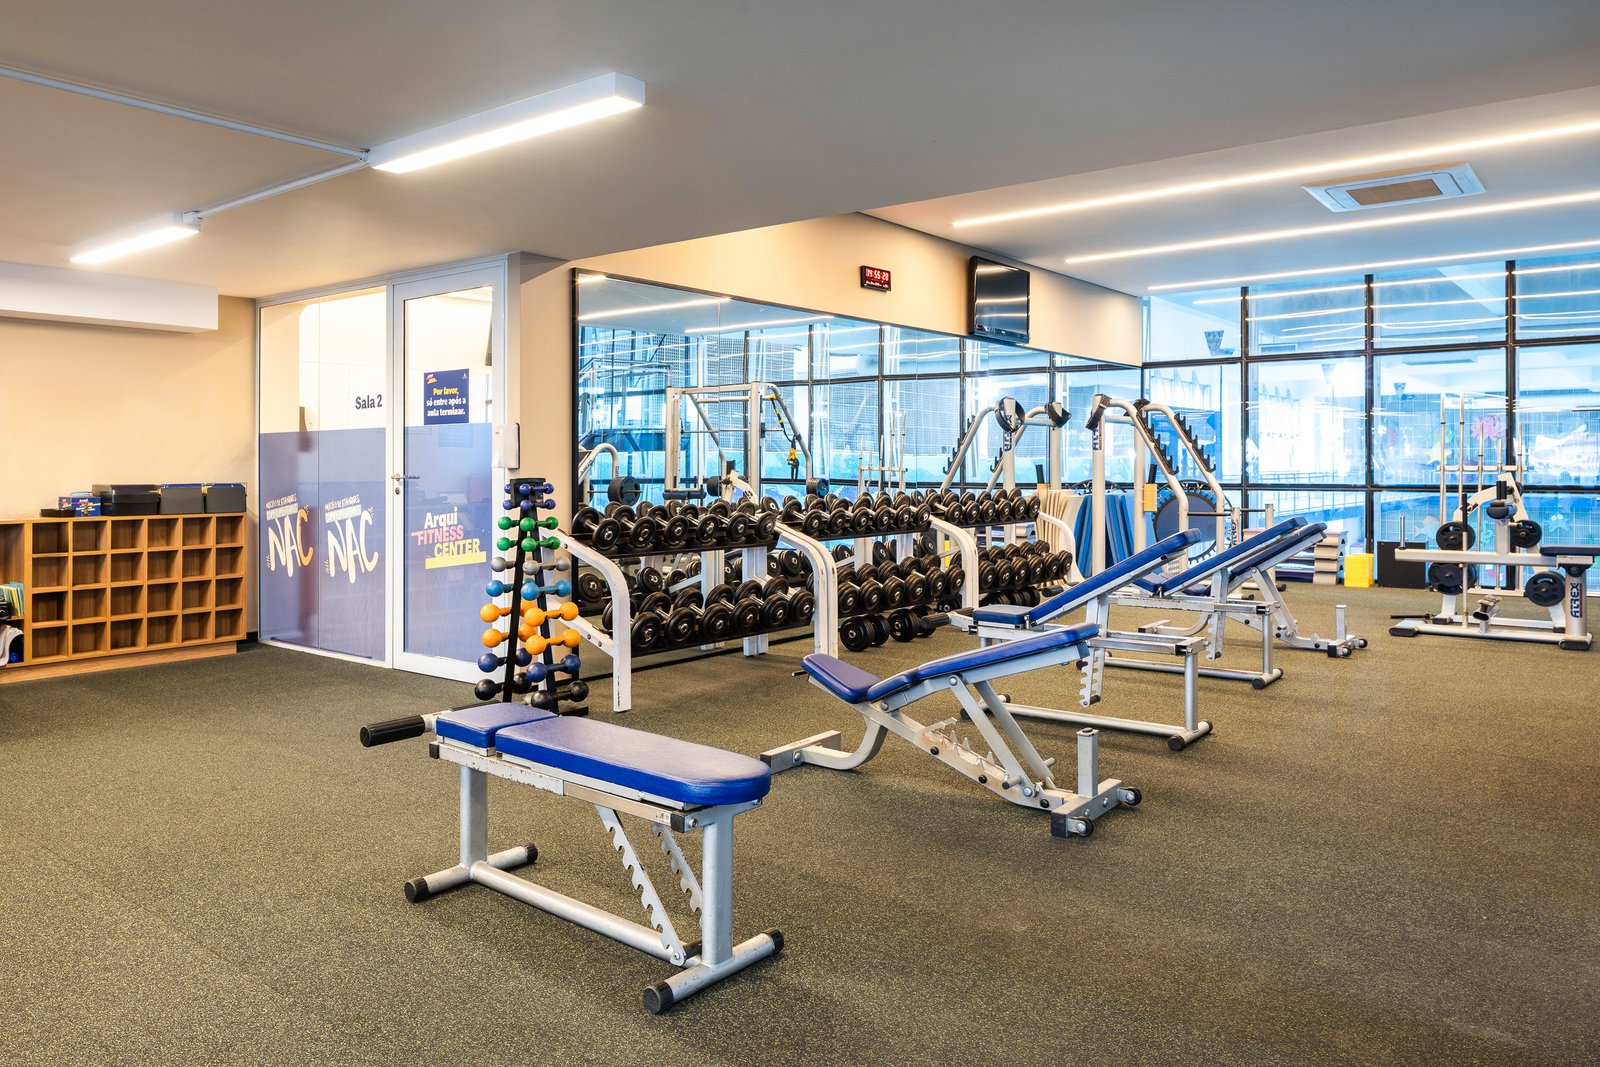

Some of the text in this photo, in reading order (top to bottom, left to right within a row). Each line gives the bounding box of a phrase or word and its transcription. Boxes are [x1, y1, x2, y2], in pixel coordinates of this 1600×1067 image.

[355, 394, 383, 410] Sala 2
[426, 397, 432, 406] só
[424, 506, 458, 530] Arqui
[268, 508, 313, 577] NAC
[411, 525, 464, 546] FITNESS
[327, 510, 379, 584] NAC
[434, 538, 481, 558] CENTER
